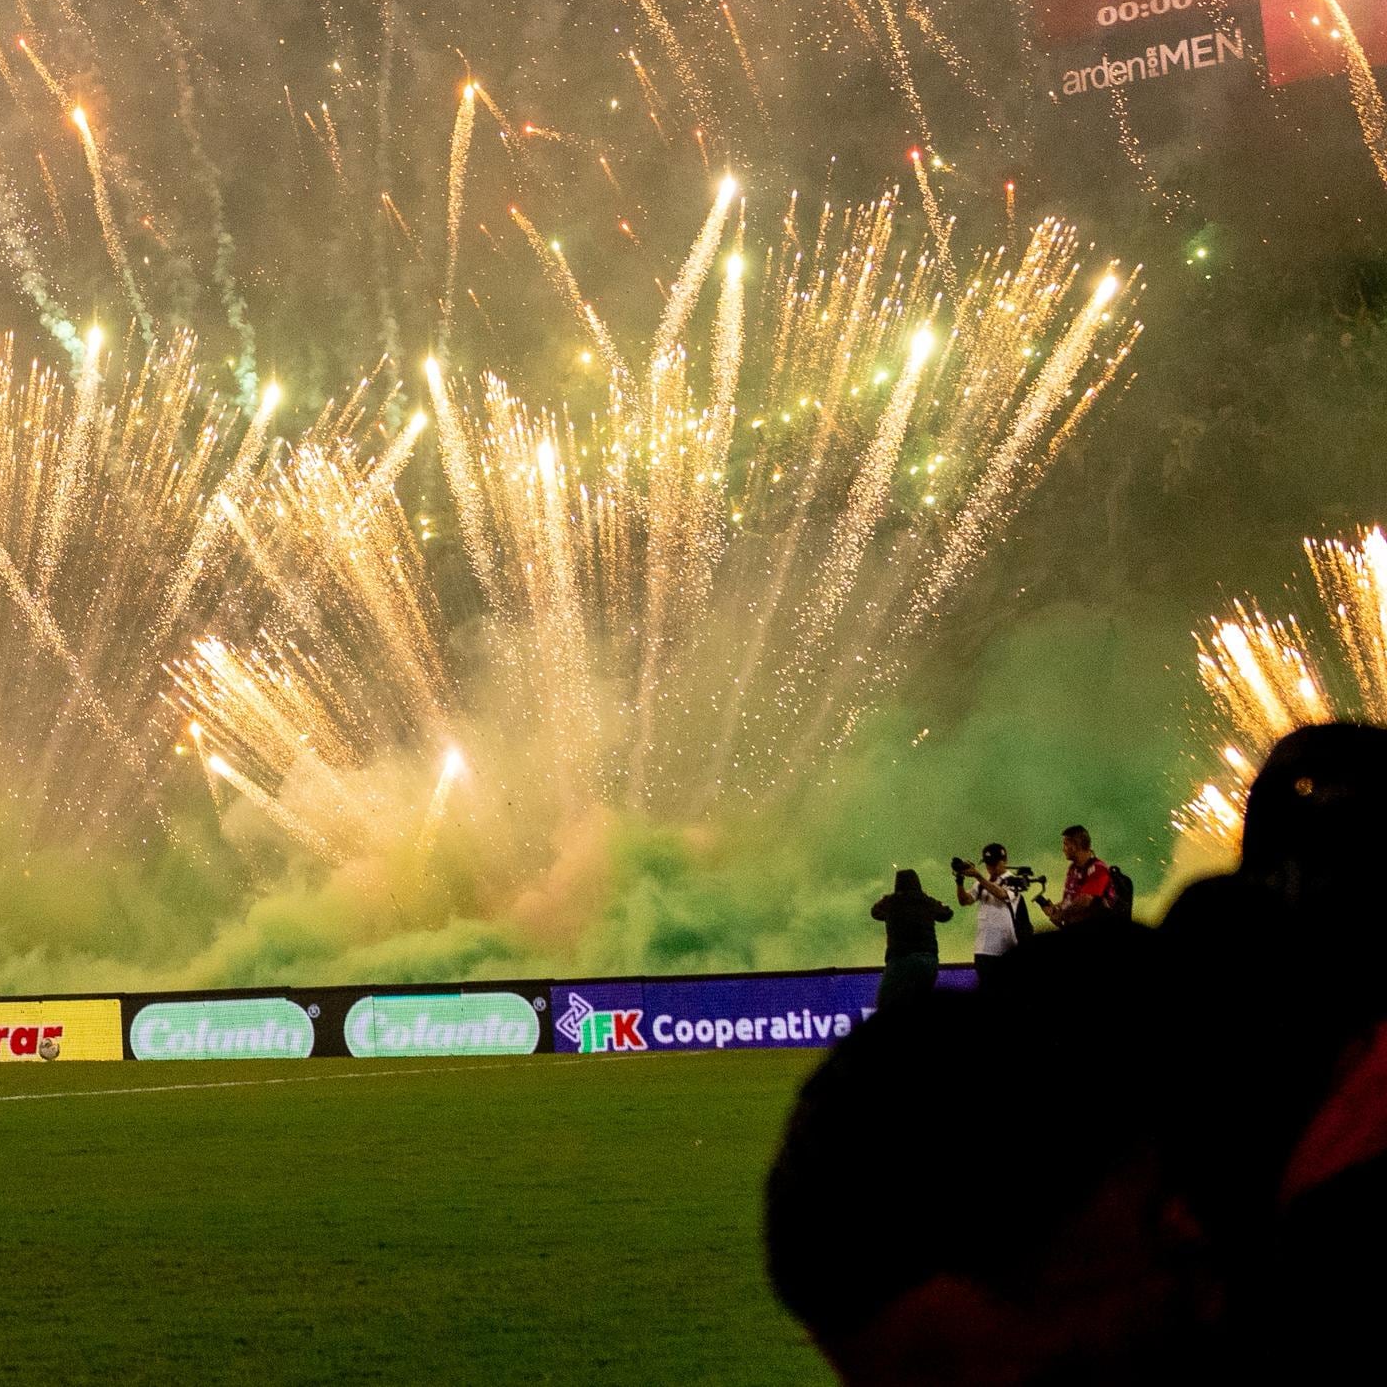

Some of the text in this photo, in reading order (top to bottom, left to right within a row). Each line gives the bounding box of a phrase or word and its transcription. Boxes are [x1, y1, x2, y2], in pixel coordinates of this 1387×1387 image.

[1062, 28, 1244, 95] arden FOR MEN
[577, 1009, 851, 1054] JFK Cooperativa
